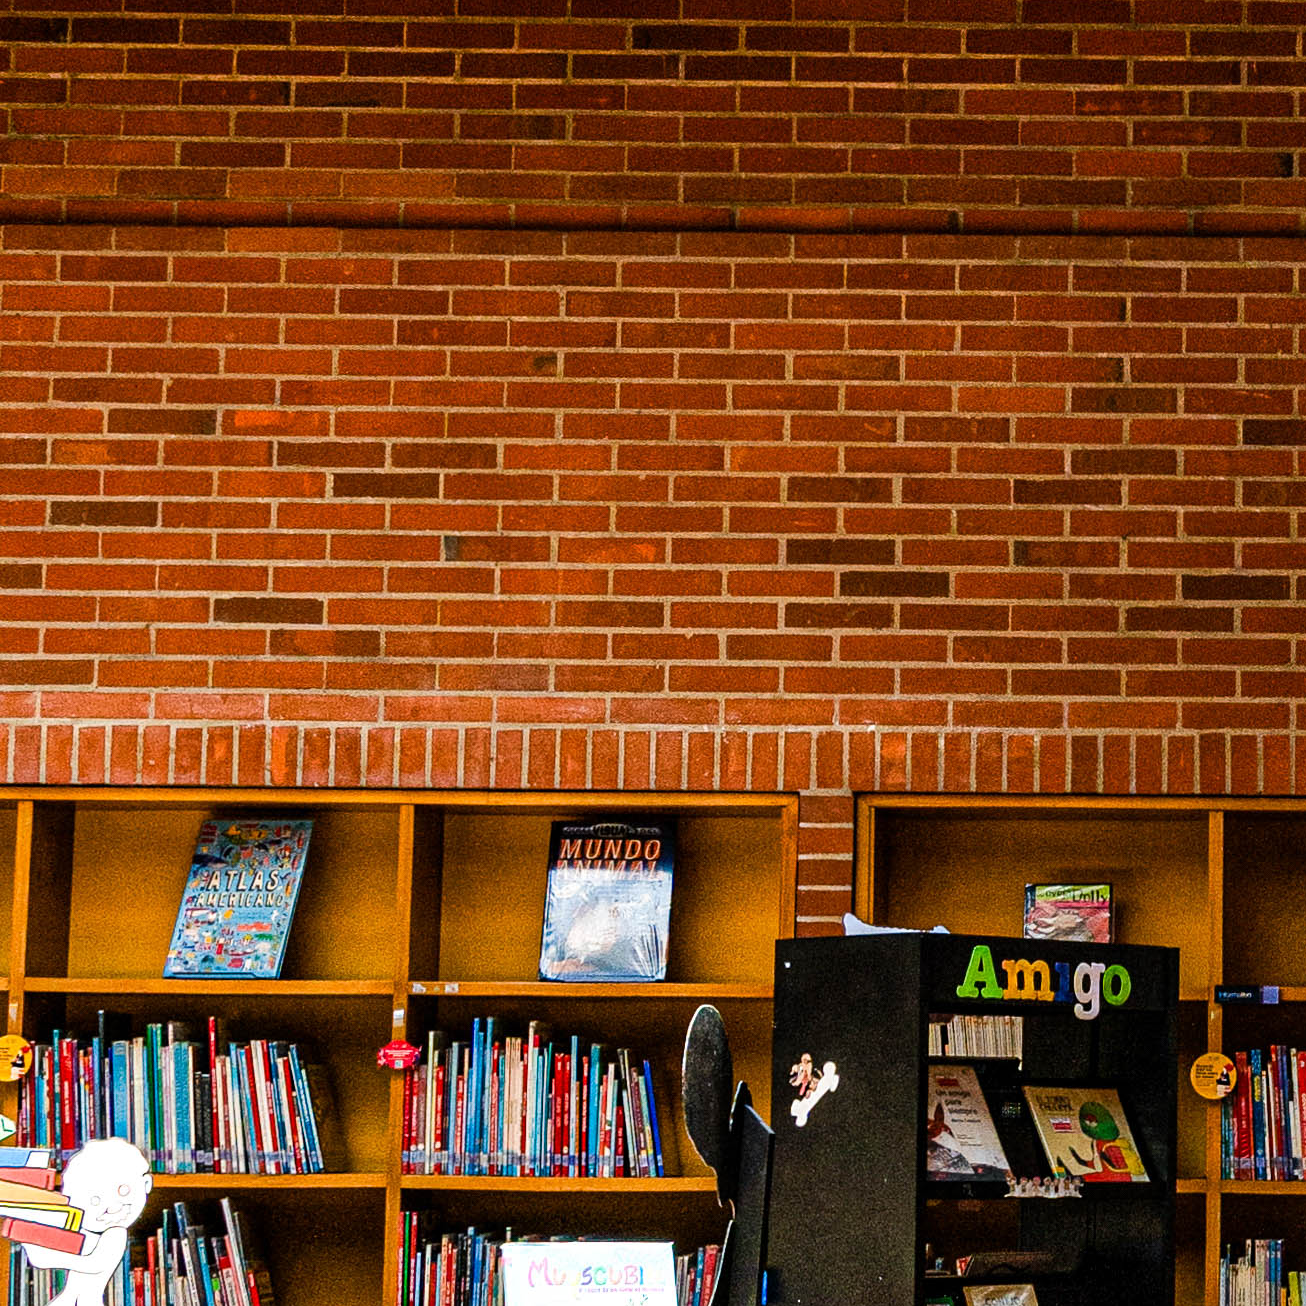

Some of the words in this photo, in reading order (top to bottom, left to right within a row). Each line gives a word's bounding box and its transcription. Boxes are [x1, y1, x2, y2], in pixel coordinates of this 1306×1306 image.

[560, 839, 661, 860] MUNDO
[205, 869, 280, 892] ATLAS
[556, 860, 663, 881] ANIMAL
[194, 892, 283, 908] AMERICANO
[956, 945, 1131, 1020] Amigo
